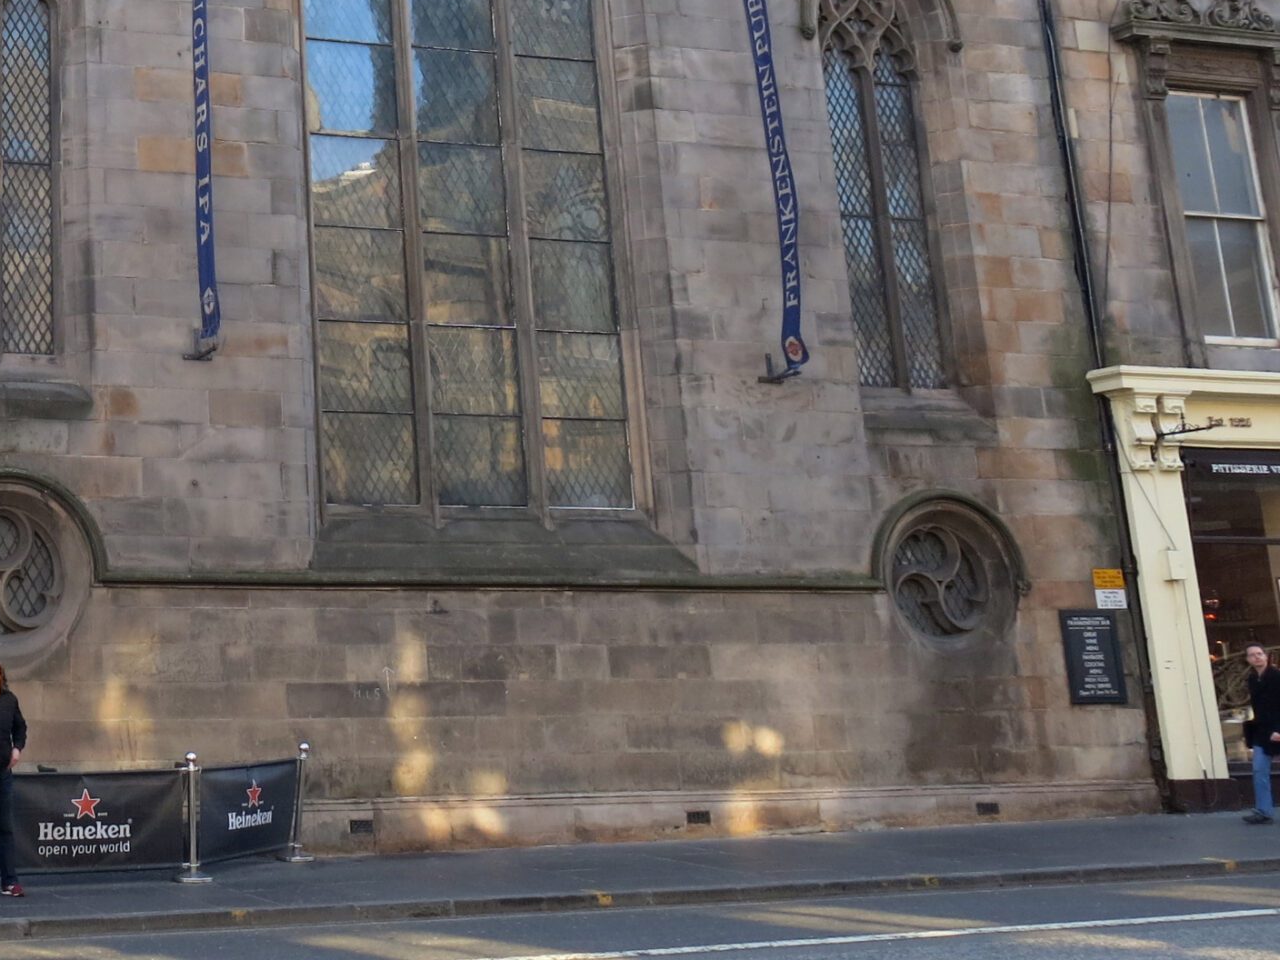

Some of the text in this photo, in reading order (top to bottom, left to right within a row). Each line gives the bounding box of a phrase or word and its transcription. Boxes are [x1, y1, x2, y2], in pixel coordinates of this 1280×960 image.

[758, 63, 798, 308] FRANKENSTEIN
[198, 173, 211, 246] IPA
[38, 820, 131, 841] Heineken
[228, 808, 273, 831] Heineken
[38, 839, 131, 858] open your world
